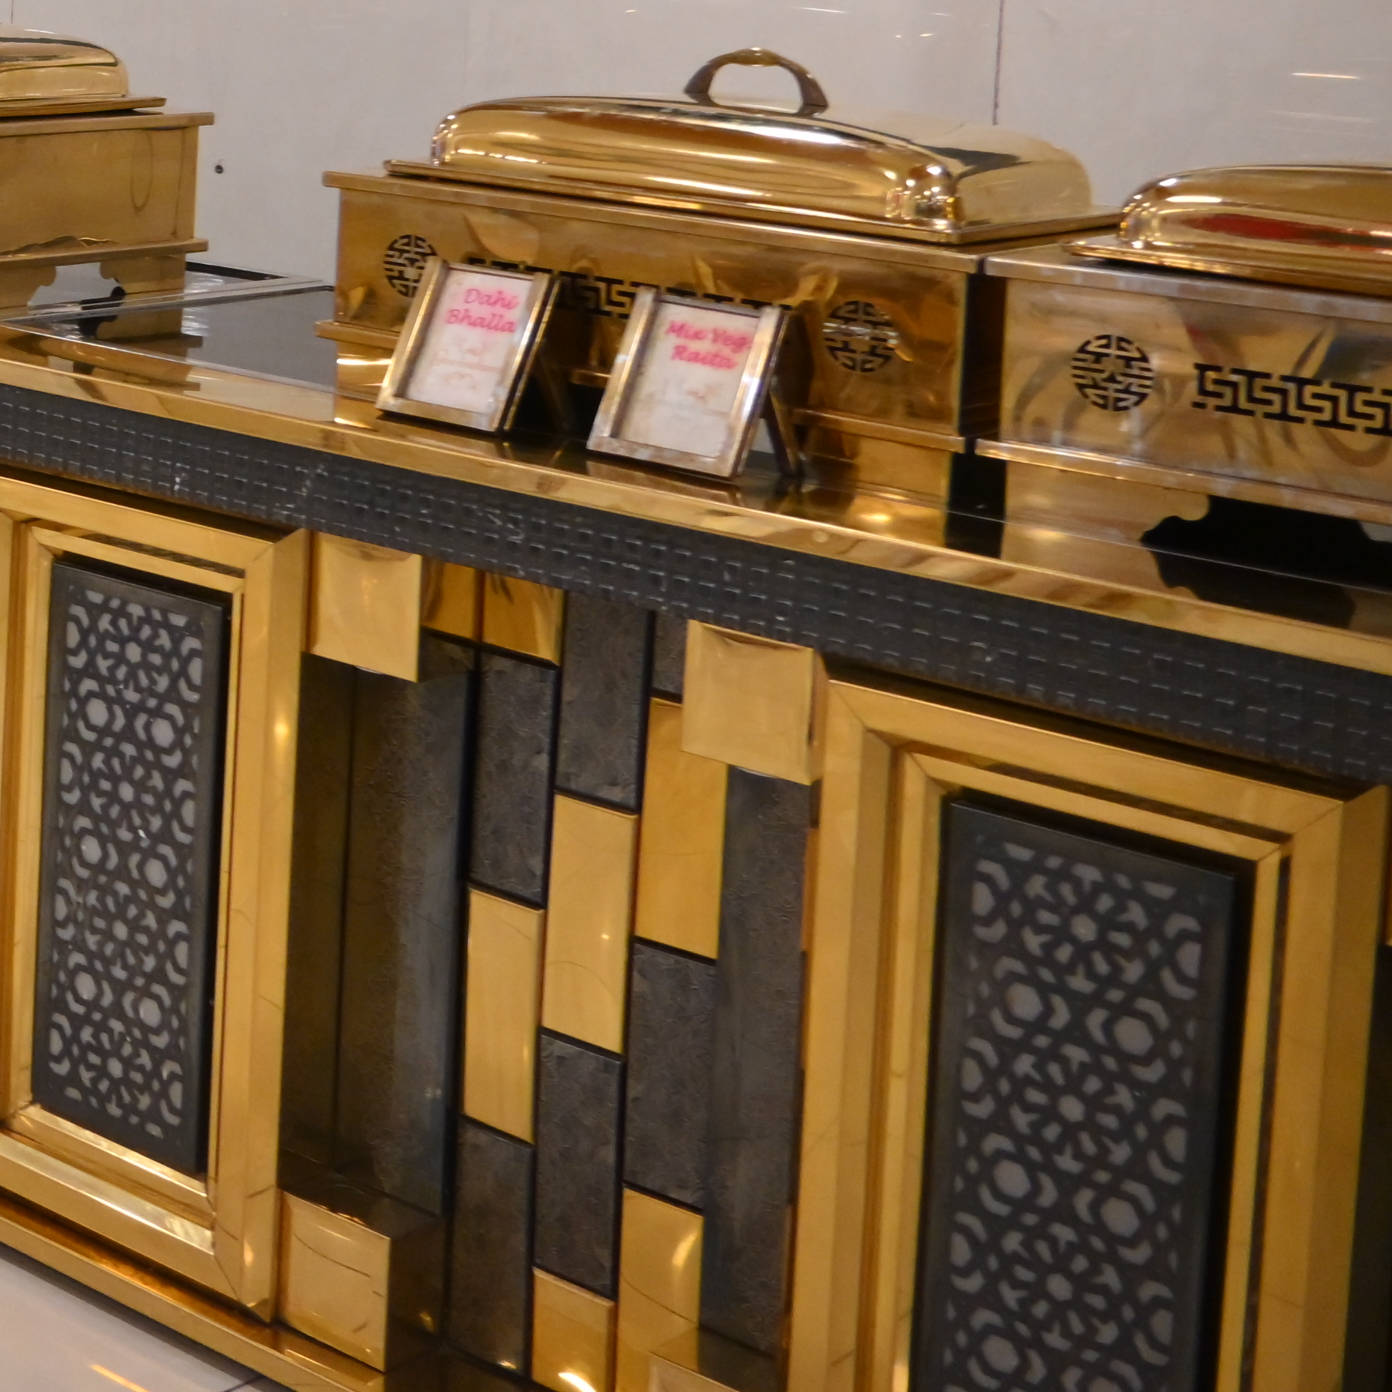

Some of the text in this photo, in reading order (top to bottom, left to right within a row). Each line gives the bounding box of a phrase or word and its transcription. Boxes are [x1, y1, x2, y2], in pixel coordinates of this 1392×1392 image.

[464, 288, 519, 310] Dahi
[446, 308, 515, 333] Bhalla
[671, 345, 737, 369] Raita
